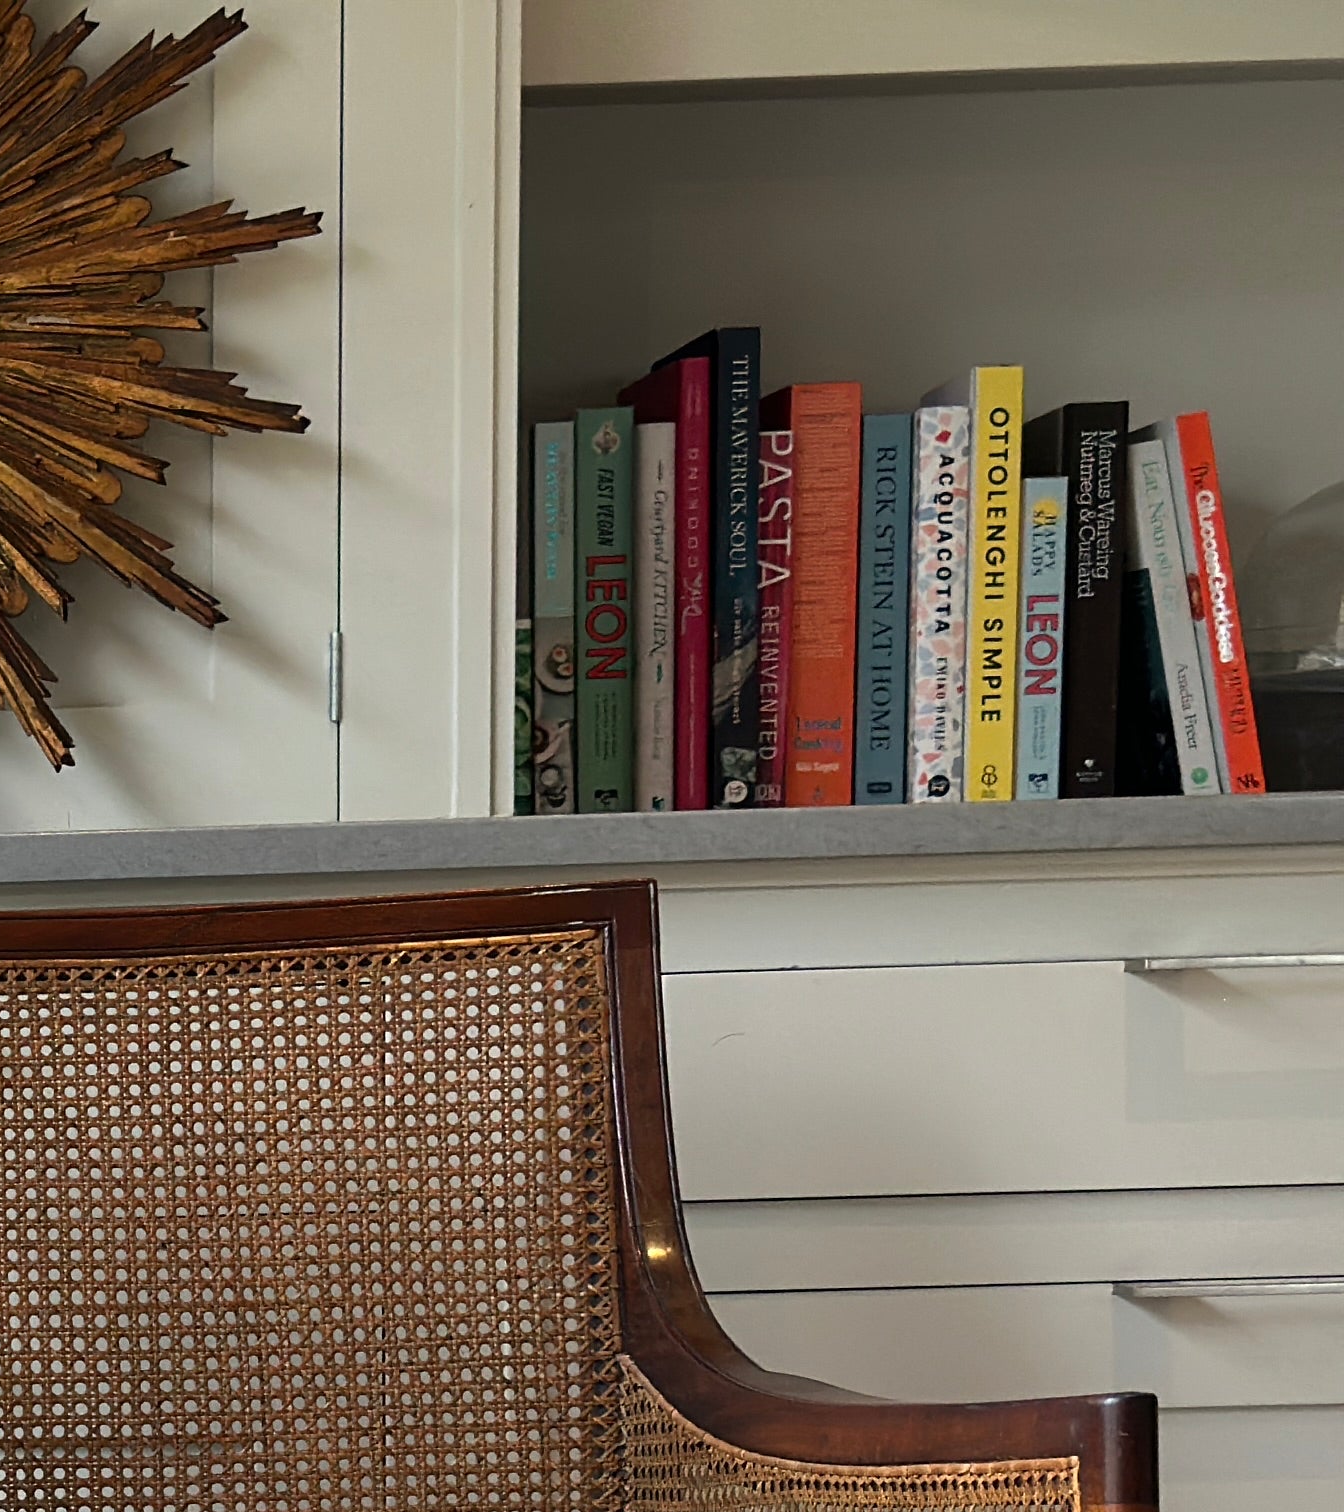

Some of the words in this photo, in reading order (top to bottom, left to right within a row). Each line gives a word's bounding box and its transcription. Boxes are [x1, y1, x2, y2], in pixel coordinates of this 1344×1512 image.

[731, 355, 750, 401] THE
[597, 468, 615, 497] FAST
[729, 406, 749, 515] MAVERICK
[875, 446, 898, 517] RICK
[1076, 431, 1098, 505] Nutmeg
[1097, 430, 1117, 499] Marcus
[595, 503, 615, 547] VEGAN
[687, 447, 700, 568] COOKING
[757, 430, 794, 589] PASTA
[984, 407, 1010, 600] OTTOLENGHI
[1079, 509, 1097, 523] &
[1092, 500, 1115, 580] Wareing
[728, 522, 748, 577] SOUL
[873, 525, 896, 610] STEIN
[933, 454, 955, 633] ACQUACOTTA
[1031, 511, 1044, 577] SALADS
[1043, 514, 1057, 570] HAPPY
[1077, 525, 1096, 599] Custard
[585, 554, 628, 680] LEON
[649, 569, 669, 656] KITCHEN
[871, 620, 894, 657] AT
[1023, 594, 1059, 696] LEON
[759, 605, 780, 760] REINVENTED
[936, 657, 948, 700] EMIKO
[981, 618, 1004, 722] SIMPLE
[869, 665, 892, 750] HOME
[933, 706, 947, 750] DAVIES
